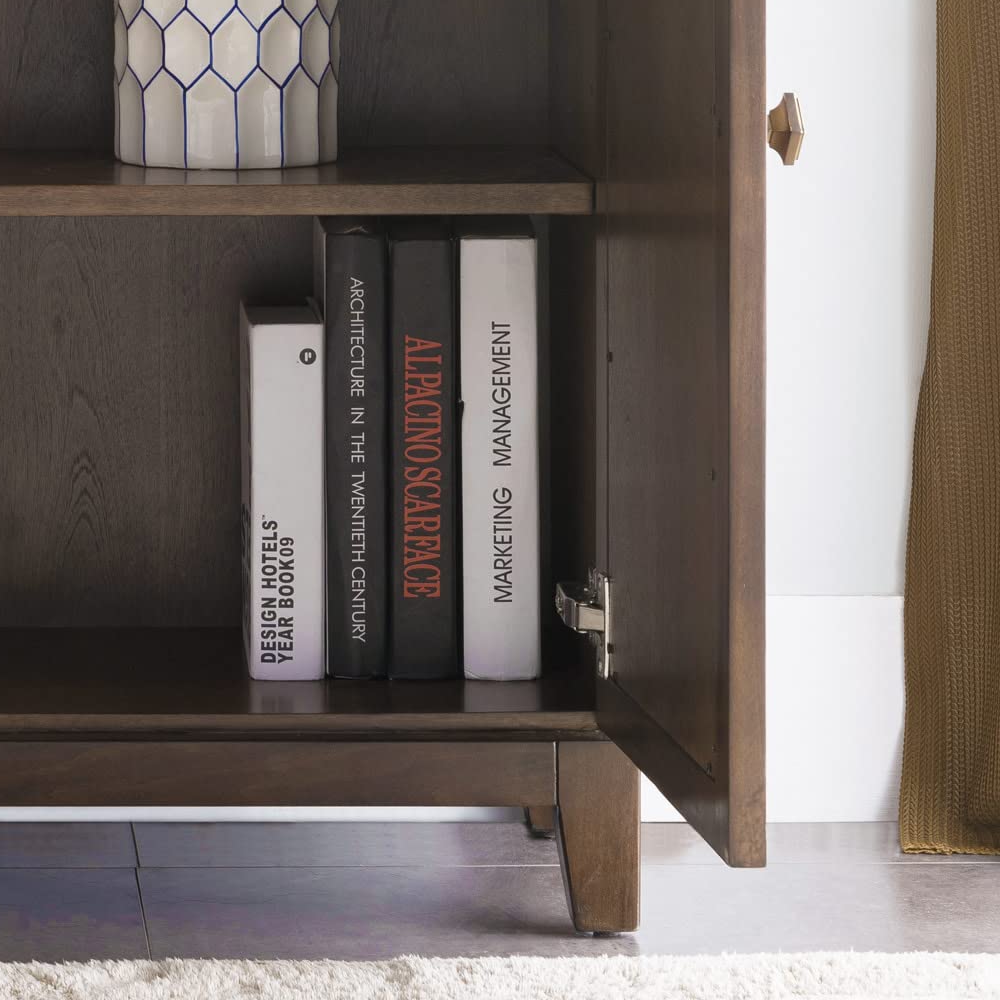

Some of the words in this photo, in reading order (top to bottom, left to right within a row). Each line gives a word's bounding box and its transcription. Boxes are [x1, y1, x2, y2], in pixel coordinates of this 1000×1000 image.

[349, 276, 365, 397] ARCHITECTURE
[350, 407, 365, 424] IN
[491, 320, 512, 467] MANAGEMENT
[350, 431, 365, 464] THE
[350, 470, 366, 562] TWENTIETH
[402, 466, 442, 599] SCARFACE
[492, 487, 513, 603] MARKETING
[260, 597, 277, 664] DESIGN
[277, 616, 294, 665] YEAR
[351, 565, 366, 643] CENTURY
